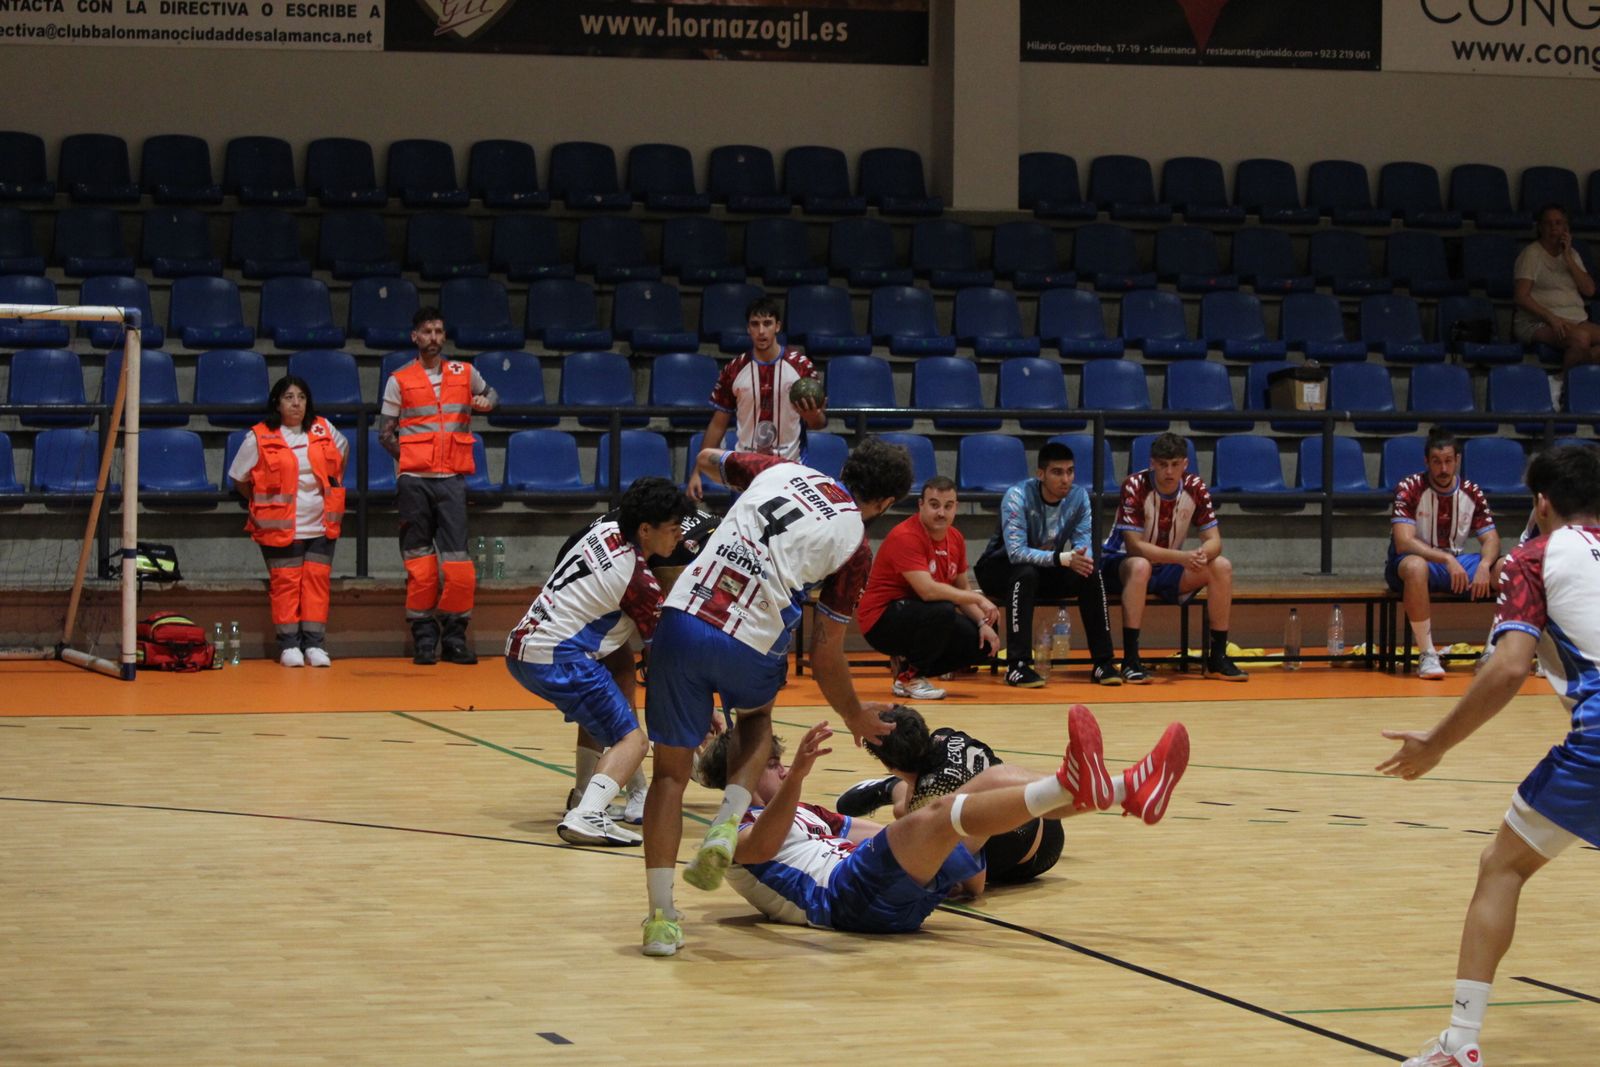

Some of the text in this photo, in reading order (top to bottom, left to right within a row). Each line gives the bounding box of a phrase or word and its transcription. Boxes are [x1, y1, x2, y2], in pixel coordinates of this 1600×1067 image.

[77, 0, 113, 14] CON
[126, 0, 147, 14] LA
[160, 1, 249, 16] DIRECTIVA
[261, 3, 273, 17] O
[286, 4, 357, 18] ESCRIBE
[369, 5, 381, 18] A
[580, 7, 849, 49] www.hornazogil.es
[1027, 41, 1056, 51] Hilario
[1117, 44, 1140, 54] 17-19
[1149, 45, 1197, 55] Salamanca
[1206, 47, 1313, 58] restauranteguinaldo.com
[1319, 49, 1337, 58] 923
[1339, 50, 1354, 59] 219
[757, 496, 805, 547] 4
[547, 554, 592, 593] 17
